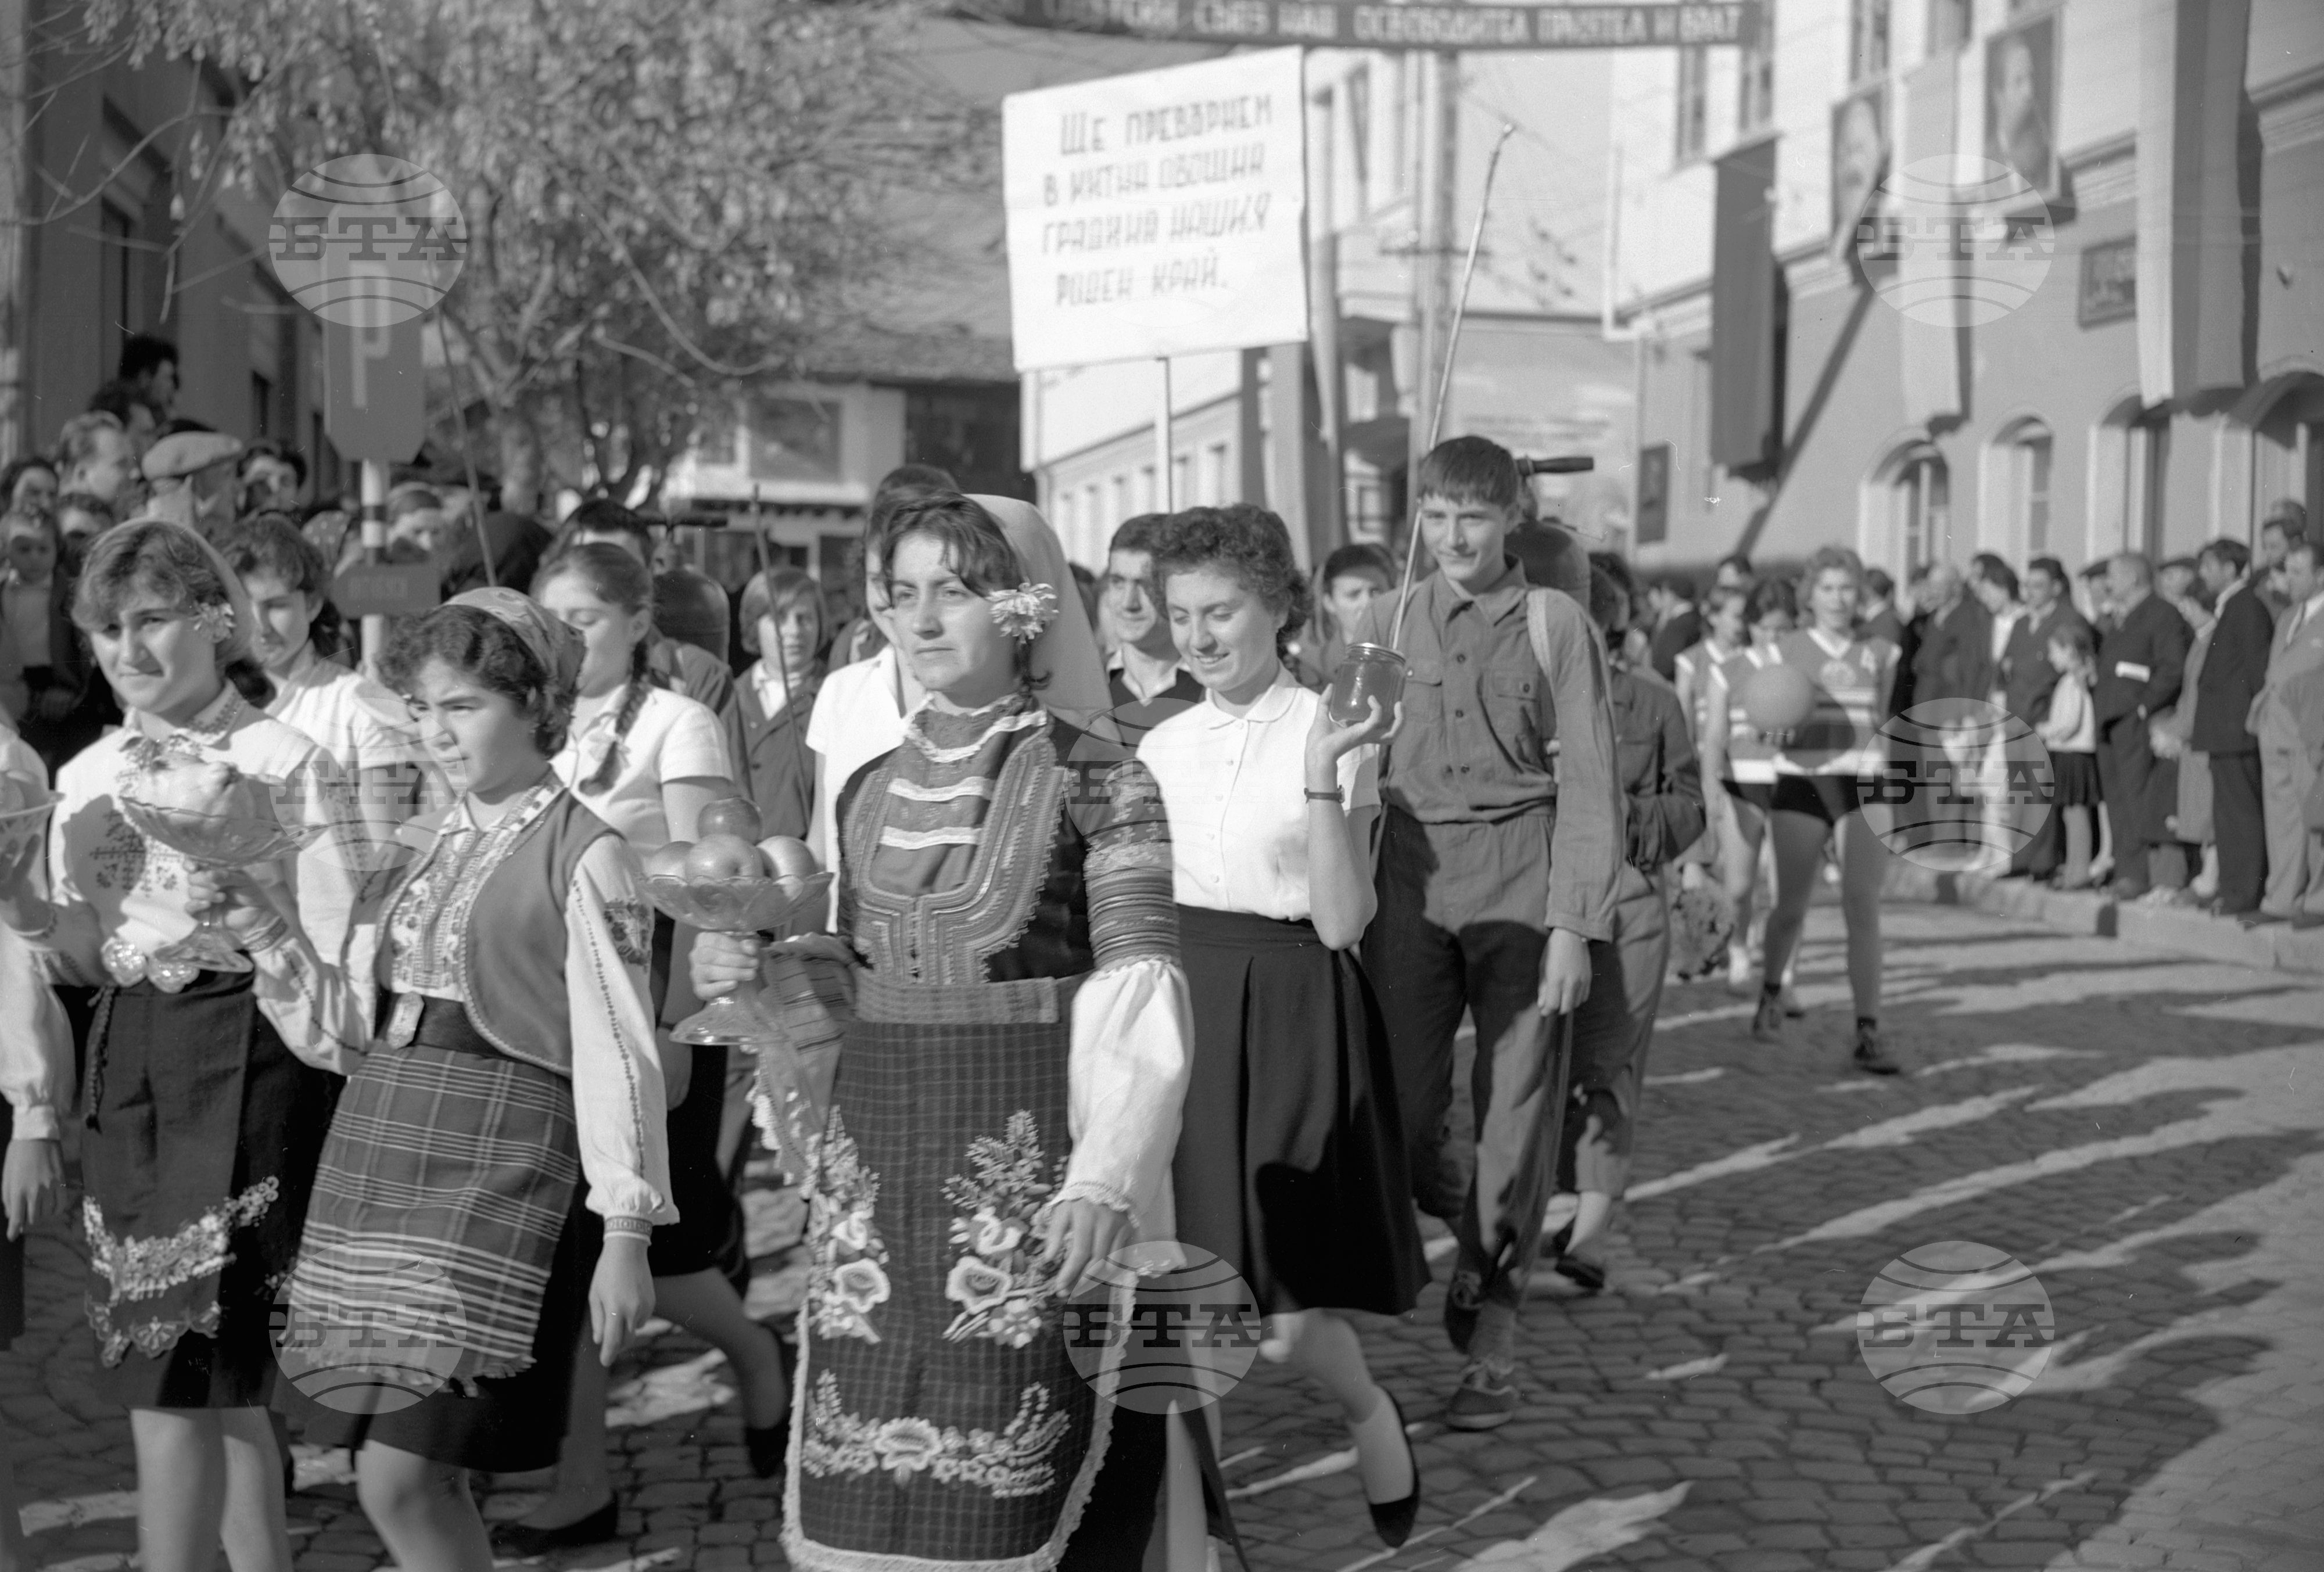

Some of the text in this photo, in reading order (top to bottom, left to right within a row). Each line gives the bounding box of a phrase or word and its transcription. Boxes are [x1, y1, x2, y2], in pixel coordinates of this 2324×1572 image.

[1044, 174, 1059, 207] В
[1043, 192, 1272, 256] ГРАДИНА НАШИЯ
[1056, 267, 1135, 307] РОДЕН
